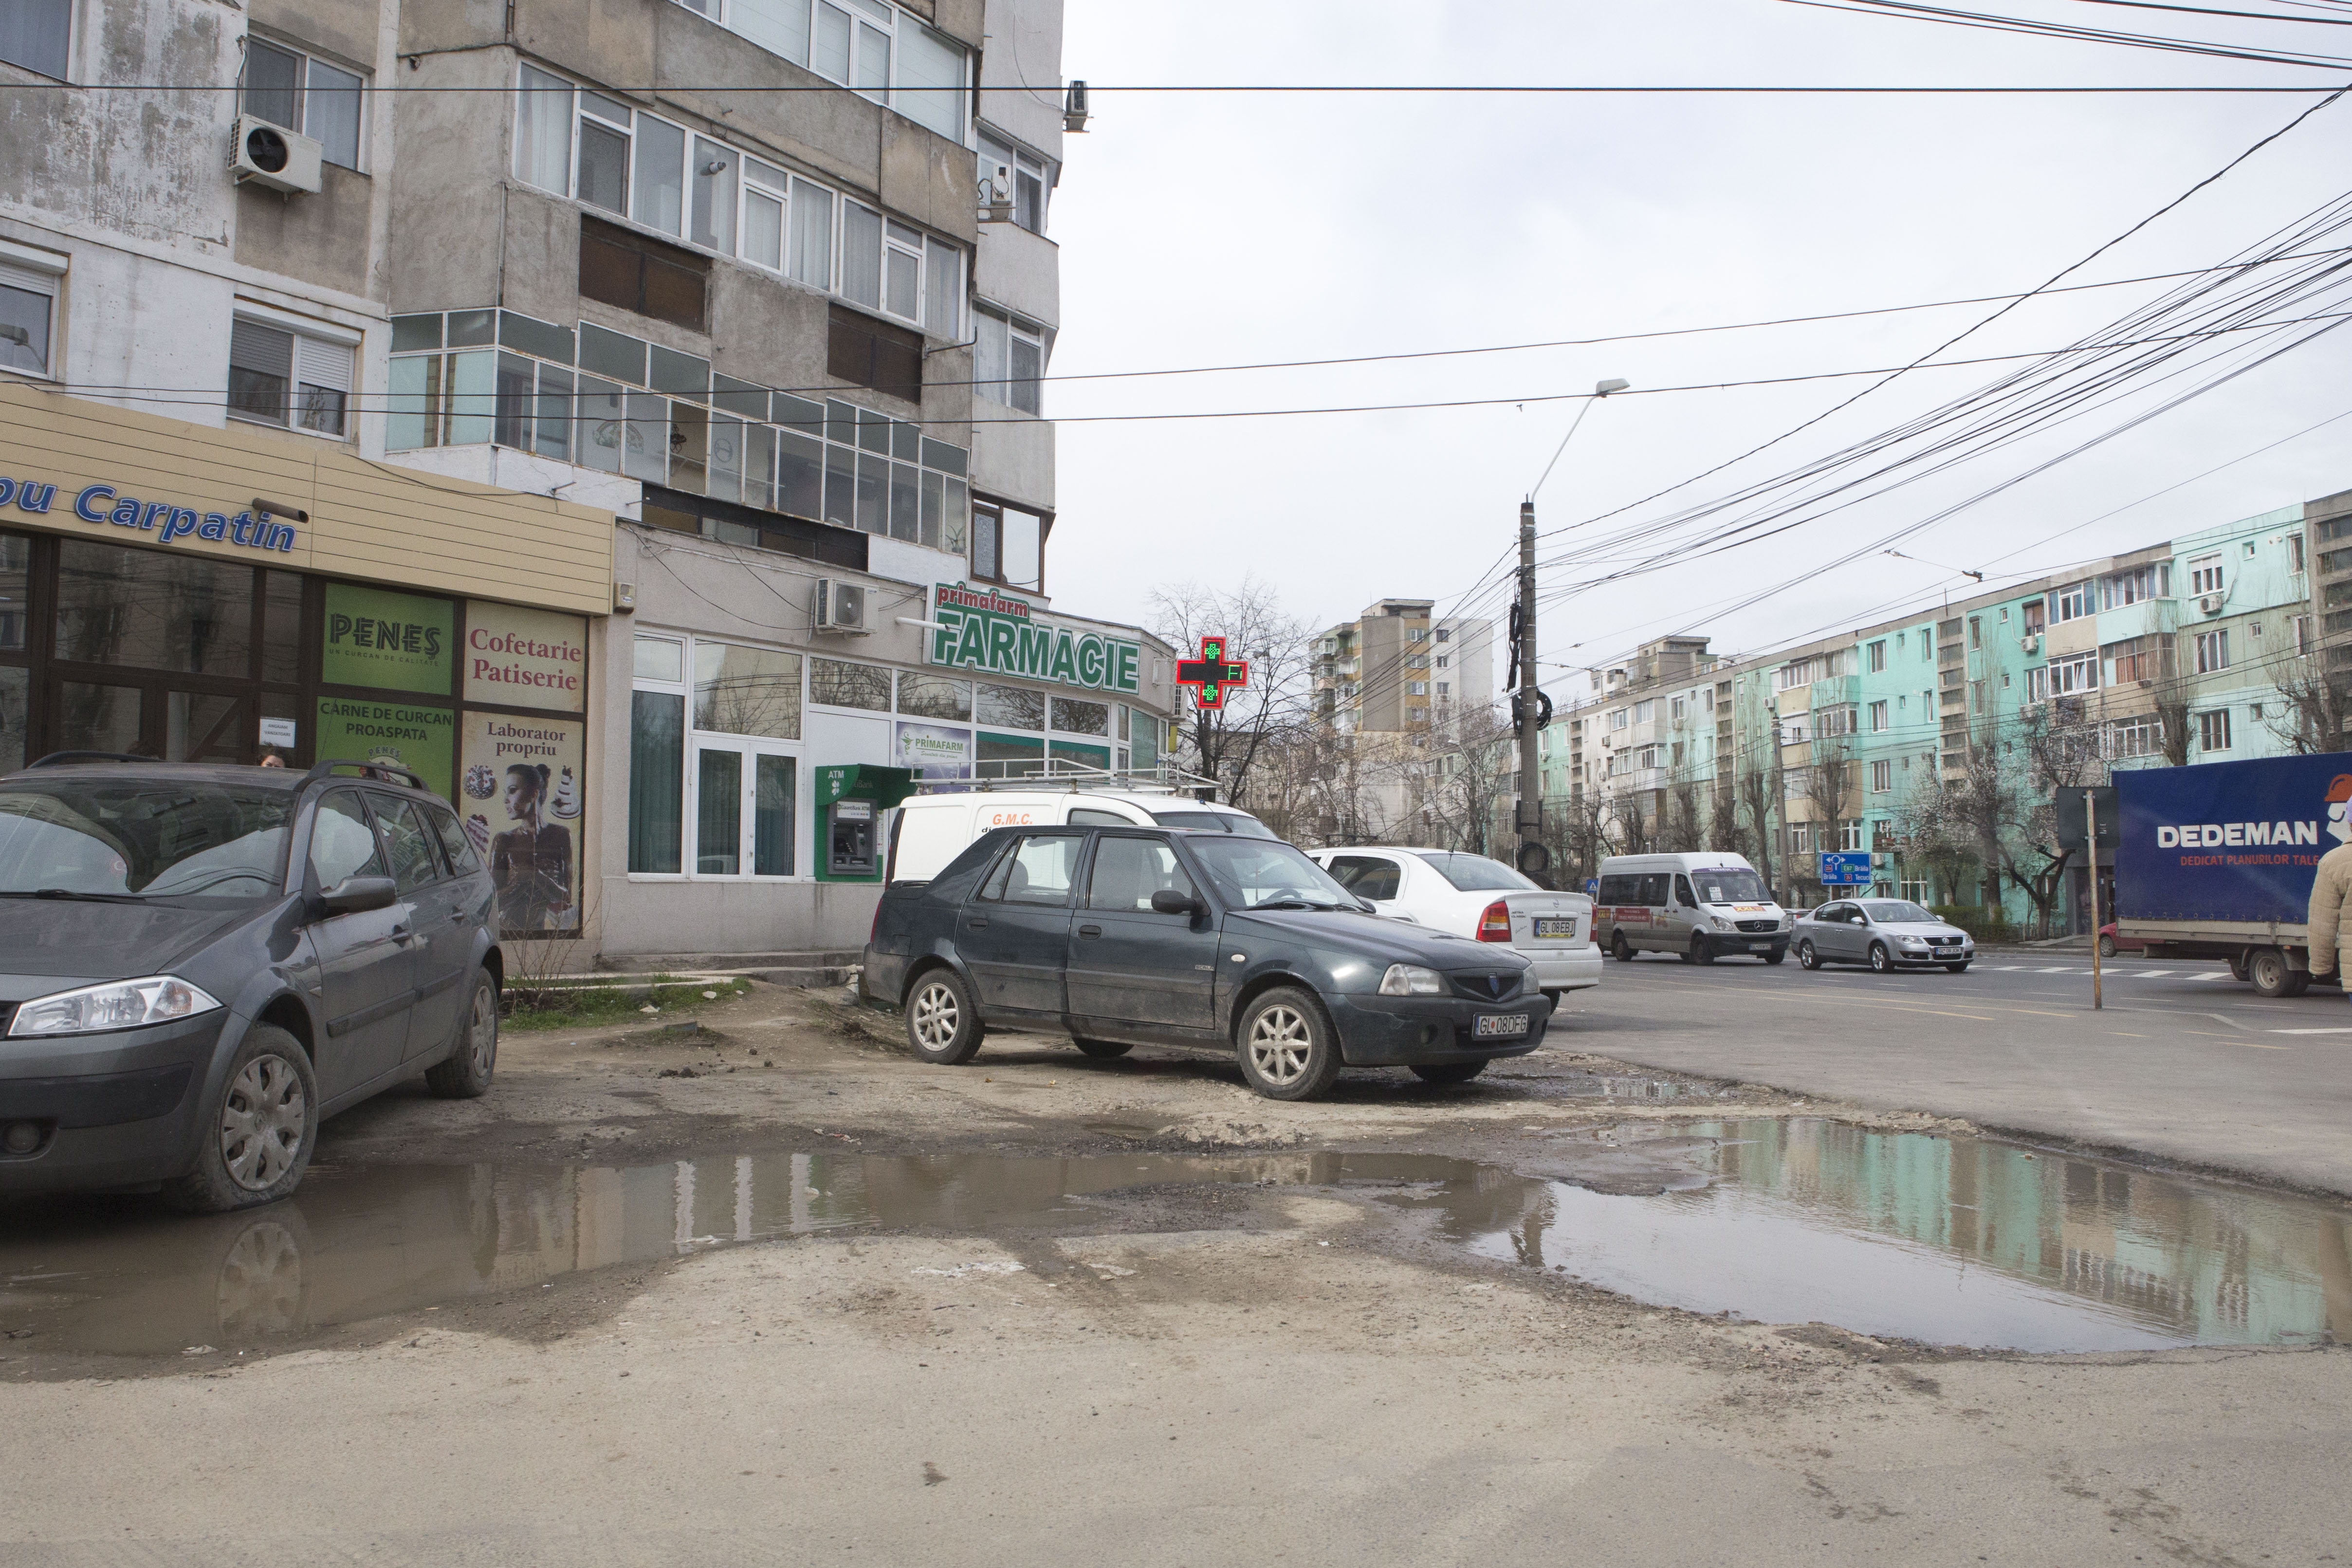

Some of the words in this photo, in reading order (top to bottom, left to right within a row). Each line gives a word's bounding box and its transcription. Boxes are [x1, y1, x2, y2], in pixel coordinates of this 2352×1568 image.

[74, 484, 297, 552] Carpatin
[937, 585, 1029, 618] primafarm
[470, 628, 581, 662] Cofetarie
[932, 608, 1140, 694] FARMACIE
[345, 650, 380, 659] CURCAN
[399, 657, 438, 666] CALITATE
[473, 659, 577, 690] Patiserie
[320, 702, 369, 718] CARNE
[373, 707, 391, 720] DE
[395, 710, 452, 725] CURCAN
[346, 723, 427, 741] PROASPATA
[487, 721, 566, 741] Laborator
[496, 742, 556, 758] propriu
[828, 771, 844, 779] ATM
[992, 813, 1033, 825] G.M.C.
[2157, 821, 2318, 848] DEDEMAN
[2180, 855, 2223, 866] DEDICAT
[2226, 854, 2289, 865] PLANURILOR
[2292, 855, 2319, 866] TALE
